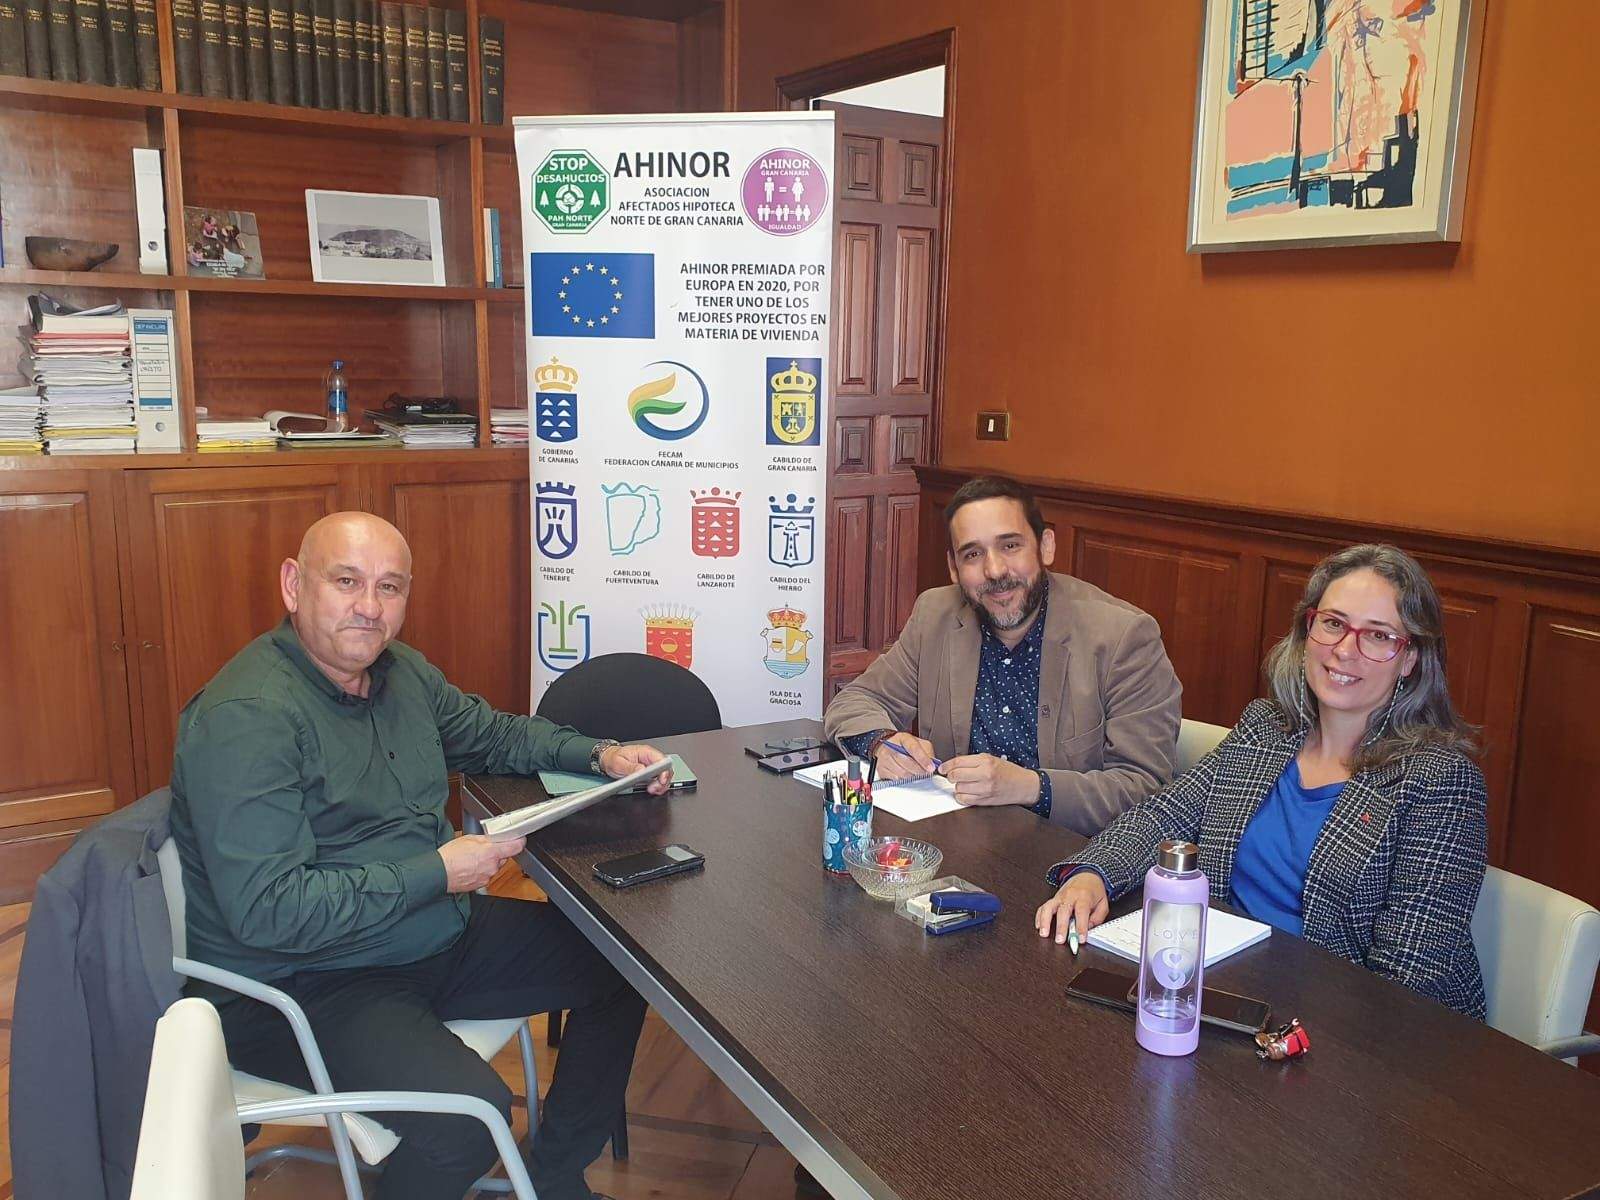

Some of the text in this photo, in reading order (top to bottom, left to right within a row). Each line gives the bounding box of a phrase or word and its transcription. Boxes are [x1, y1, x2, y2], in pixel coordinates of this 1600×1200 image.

[549, 158, 588, 170] STOP
[614, 151, 730, 178] AHINOR
[760, 159, 810, 169] AHINOR
[537, 174, 605, 183] DESAHUCIOS
[644, 188, 710, 197] ASOCIACION
[619, 202, 735, 211] AFECTADOS HIPOTECA
[611, 216, 744, 225] NORTE DE GRAN CANARIA
[680, 263, 824, 275] AHINOR PREMIADA POR
[686, 280, 819, 293] EUROPA EN 2020, POR
[696, 296, 809, 308] TENER UNO DE LOS
[678, 312, 826, 324] MEJORES PROYECTOS EN
[685, 328, 819, 341] MATERIA DE VIVIENDA
[659, 451, 683, 459] FECAM
[651, 459, 683, 468] CANARIA
[1154, 928, 1198, 941] LOVE
